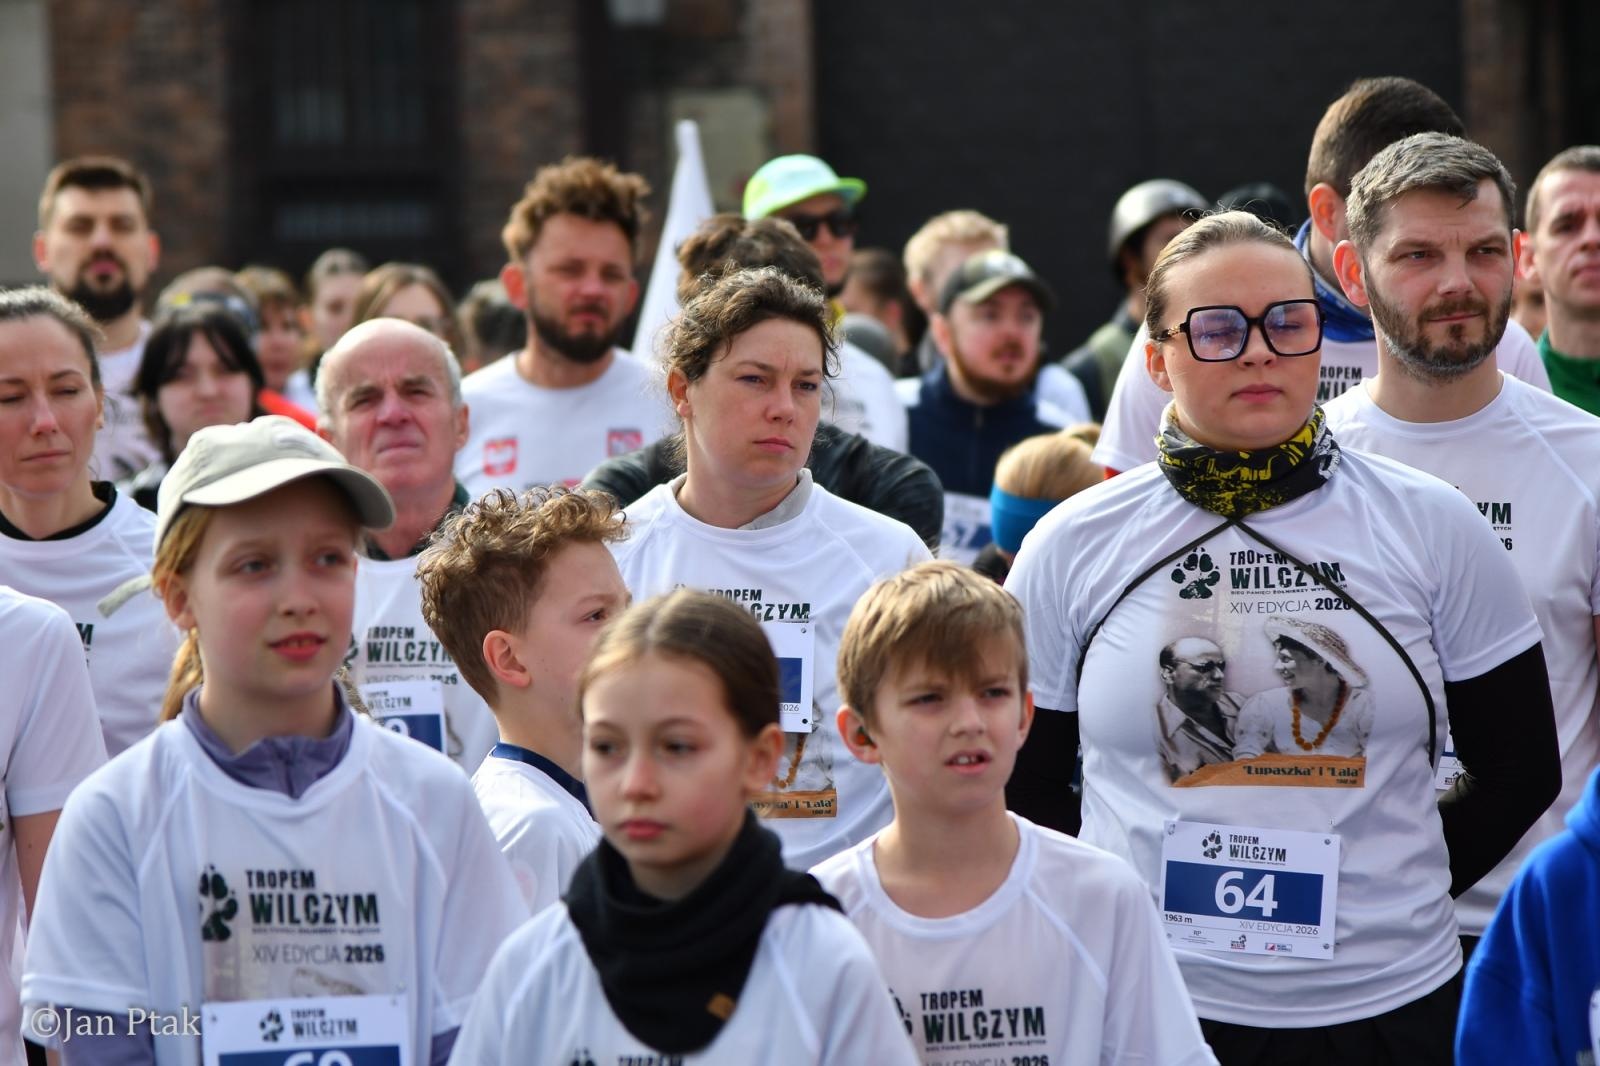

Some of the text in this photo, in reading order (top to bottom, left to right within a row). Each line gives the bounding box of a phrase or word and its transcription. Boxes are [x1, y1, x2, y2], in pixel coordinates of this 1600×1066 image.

[1320, 365, 1362, 380] ROPEM
[1230, 550, 1288, 565] TROPEM
[1230, 602, 1254, 614] XIV
[1257, 600, 1312, 613] EDYCJA
[1229, 833, 1259, 845] TROPEM
[1229, 844, 1286, 862] WILCZYM
[246, 870, 315, 889] TROPEM
[1215, 870, 1277, 917] 64
[249, 893, 379, 925] WILCZYM
[1164, 913, 1183, 923] 1963
[1239, 920, 1319, 935] XIV EDYCJA 2026
[252, 944, 385, 964] XIV EDYCJA 2026
[920, 989, 984, 1011] TROPEM
[293, 1018, 357, 1038] WILCZYM
[922, 1006, 1046, 1044] WILCZYM
